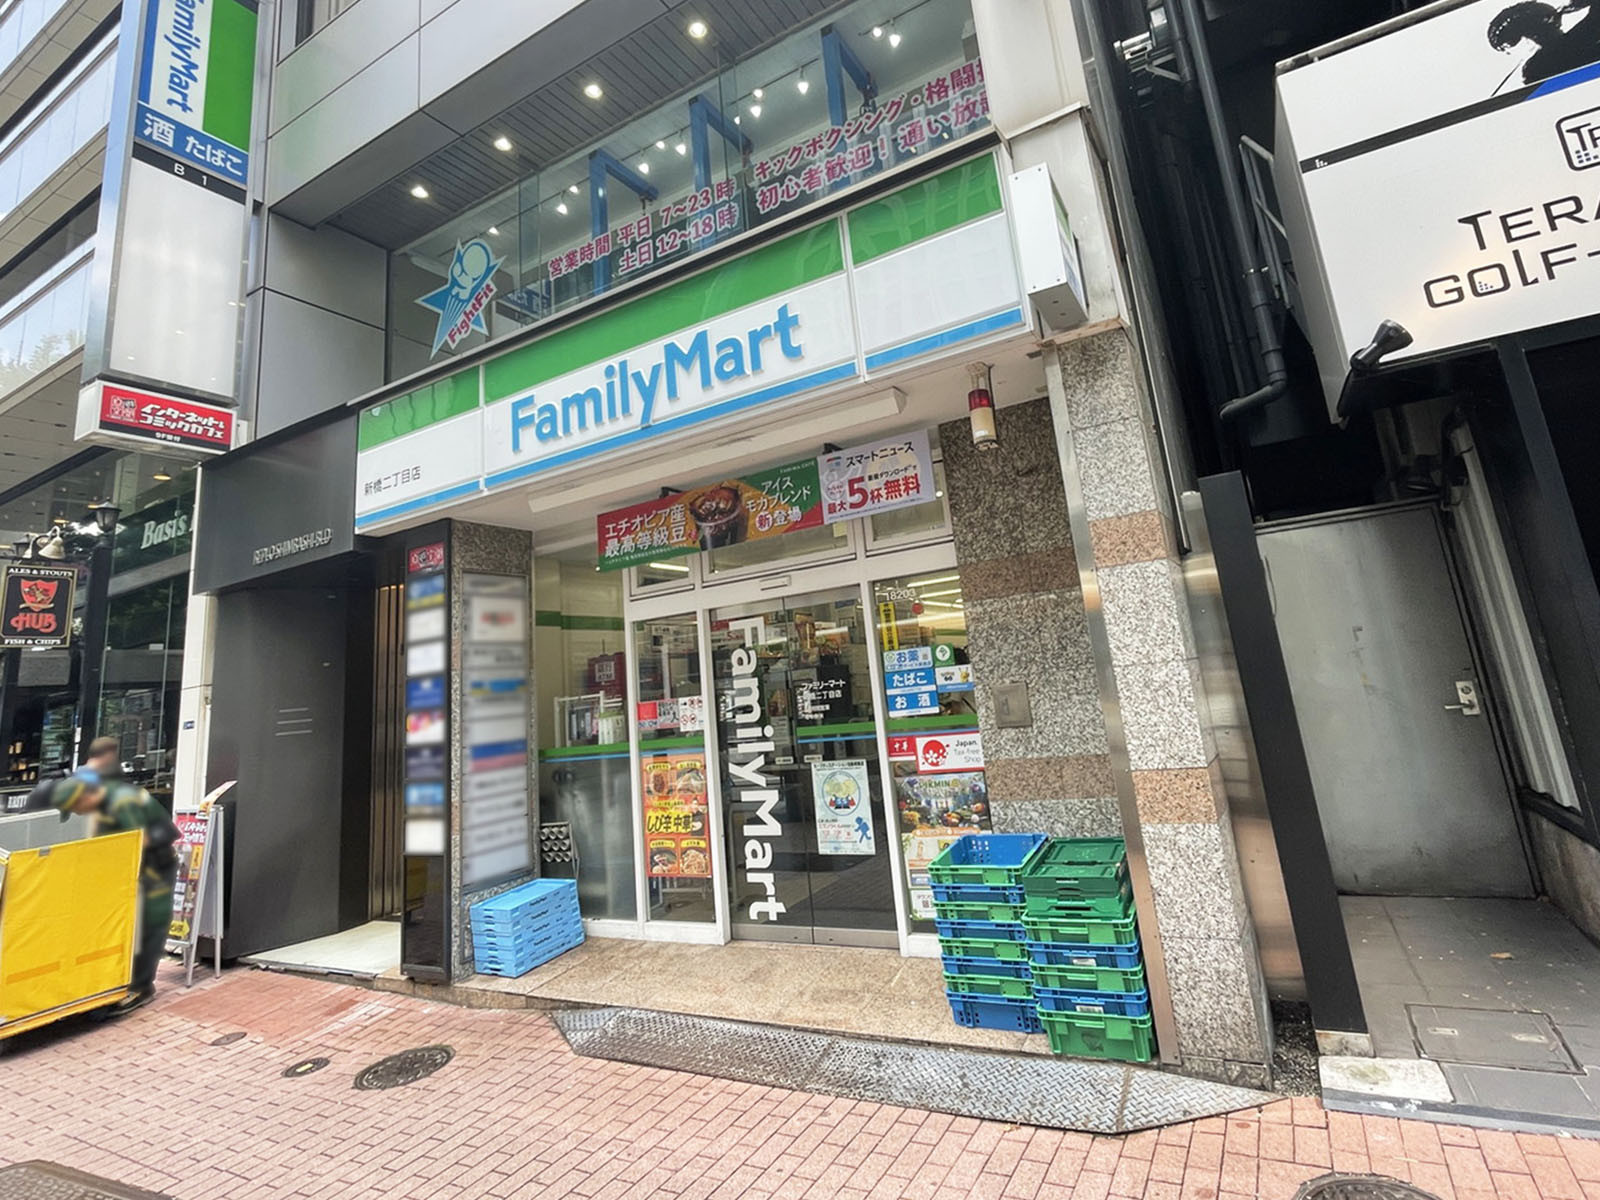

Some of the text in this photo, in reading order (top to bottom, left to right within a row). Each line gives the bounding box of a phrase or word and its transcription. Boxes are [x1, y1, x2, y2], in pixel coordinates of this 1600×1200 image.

[164, 0, 205, 113] amilyMart
[144, 113, 242, 176] 酒 たばこ
[1457, 195, 1600, 251] TER
[549, 234, 612, 279] 営業時間
[618, 217, 651, 244] 平日
[619, 242, 653, 274] 土日
[448, 282, 494, 344] FightFit
[511, 302, 804, 452] FamilyMart
[139, 413, 224, 439] コミックカフェ
[846, 442, 914, 467] スマートニュース
[364, 465, 421, 496] 新橋二丁目店
[761, 477, 794, 495] アイス
[746, 486, 811, 512] モカブレンド
[140, 510, 188, 549] Basis
[605, 503, 686, 538] エチオピア産
[755, 505, 802, 532] 新登場
[605, 526, 687, 558] 最高等級豆
[8, 567, 31, 575] ALES
[10, 612, 57, 633] HUB
[801, 679, 846, 690] ファミリーマート
[892, 671, 928, 687] たばこ
[728, 616, 787, 921] FamilyMart
[646, 814, 691, 832] しび辛中華
